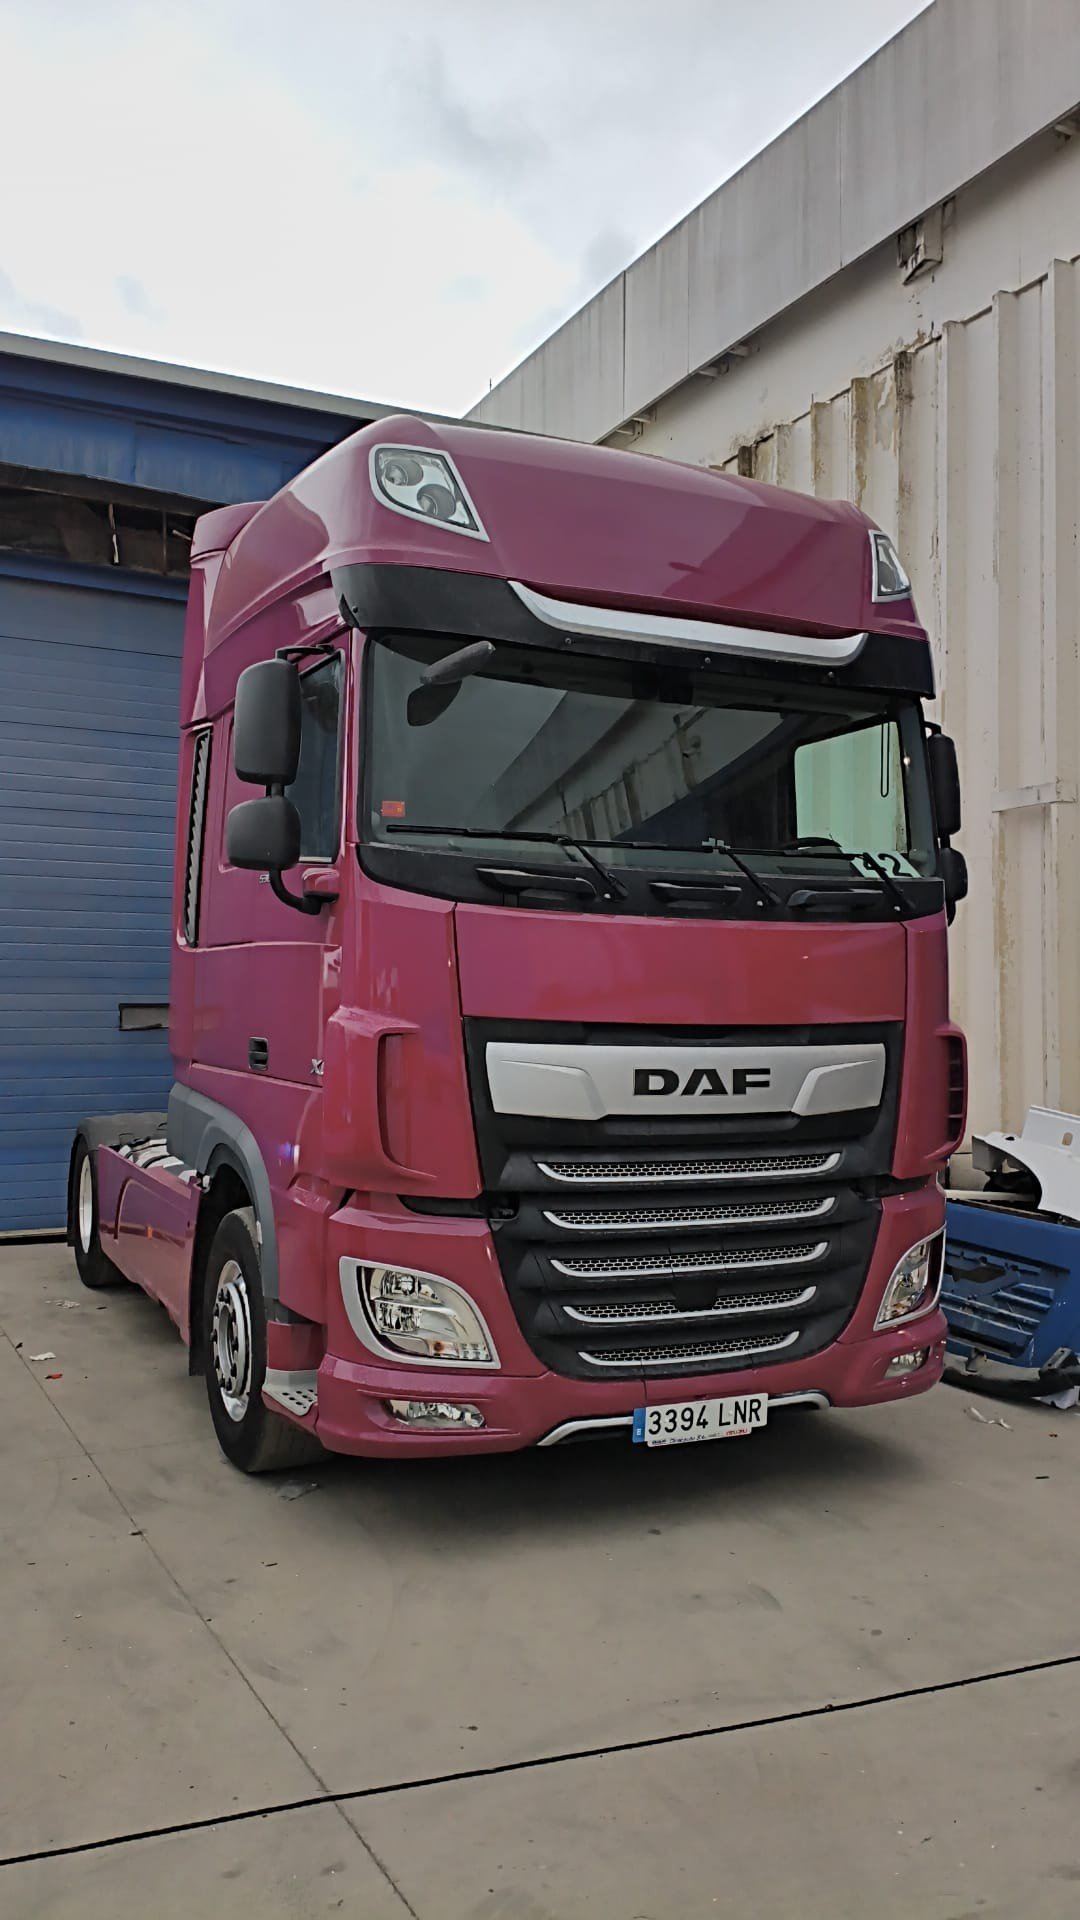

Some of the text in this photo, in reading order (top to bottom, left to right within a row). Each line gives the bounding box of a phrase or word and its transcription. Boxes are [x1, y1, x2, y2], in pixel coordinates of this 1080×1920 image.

[633, 1067, 771, 1096] DAF
[648, 1398, 761, 1435] 3394 LNR
